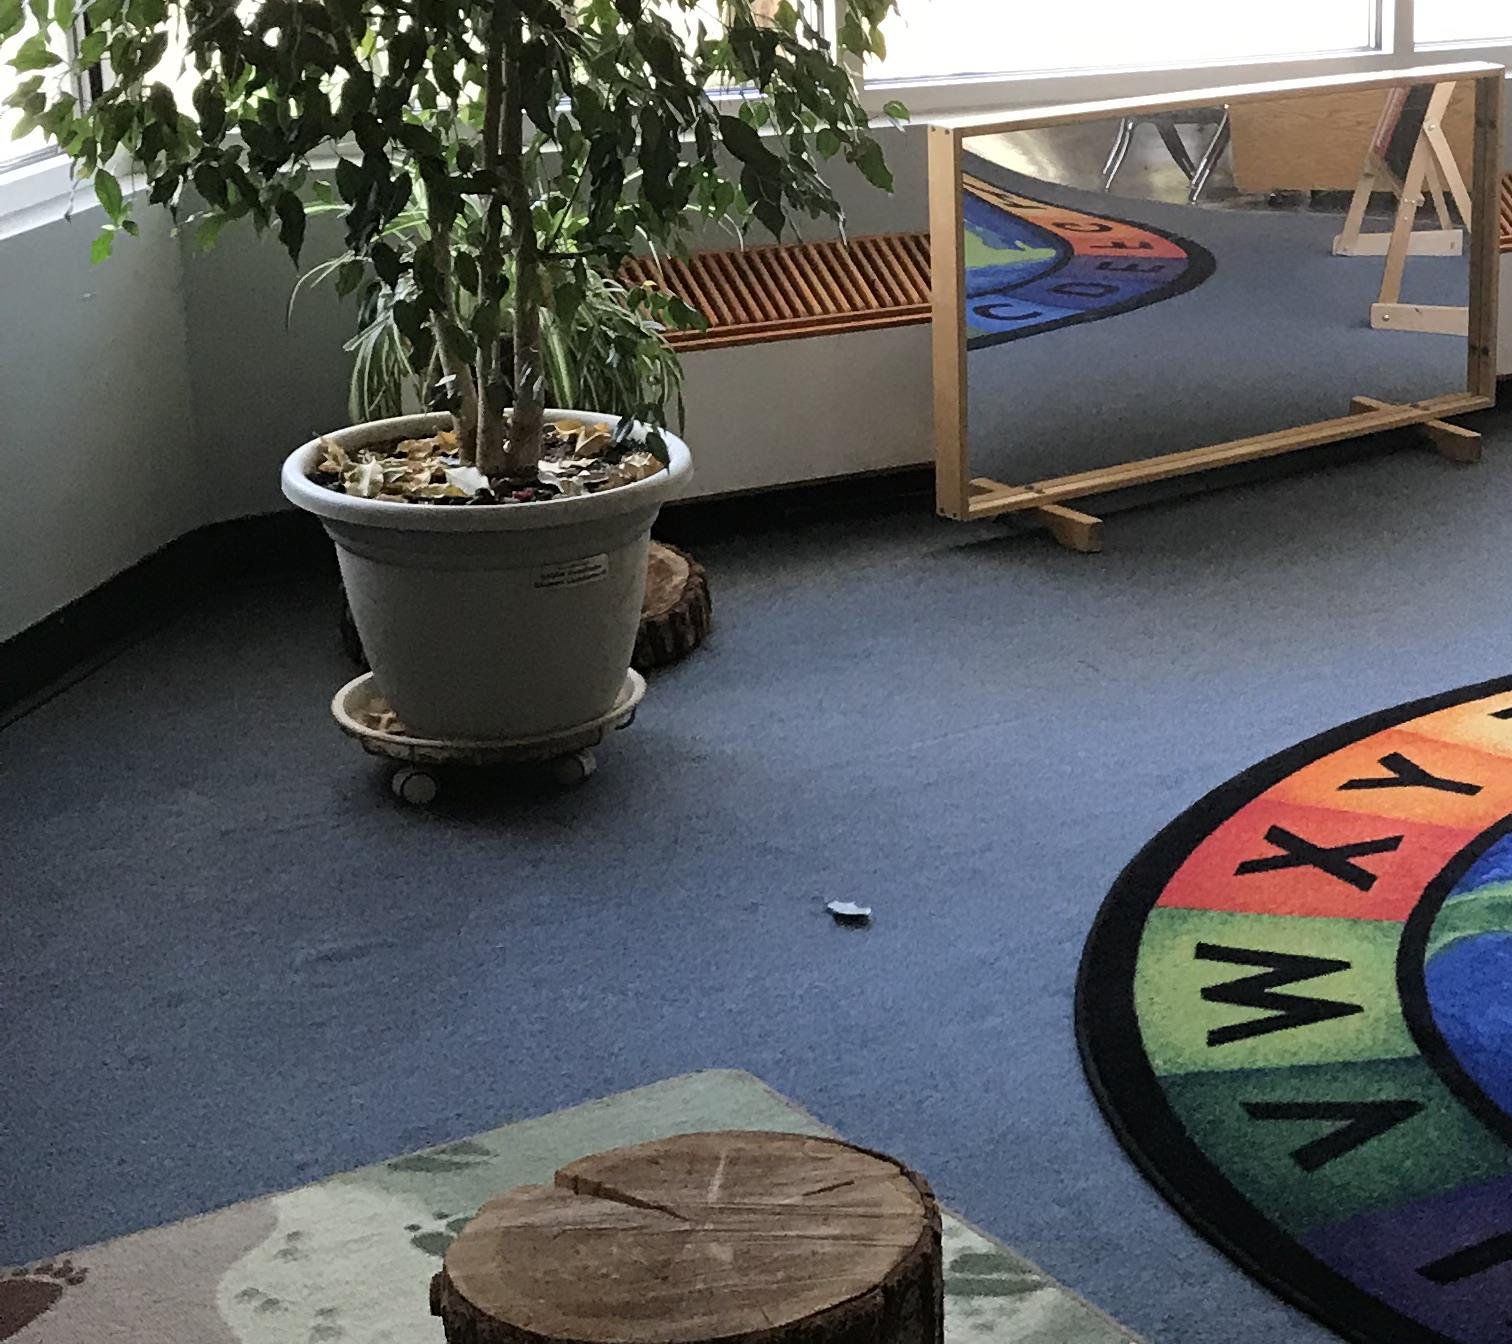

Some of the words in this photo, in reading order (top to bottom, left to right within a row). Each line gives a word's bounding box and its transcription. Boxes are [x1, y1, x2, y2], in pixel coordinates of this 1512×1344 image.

[1337, 751, 1483, 796] Y
[1233, 824, 1404, 892] X
[1195, 942, 1364, 1047] W
[1239, 1102, 1428, 1172] V
